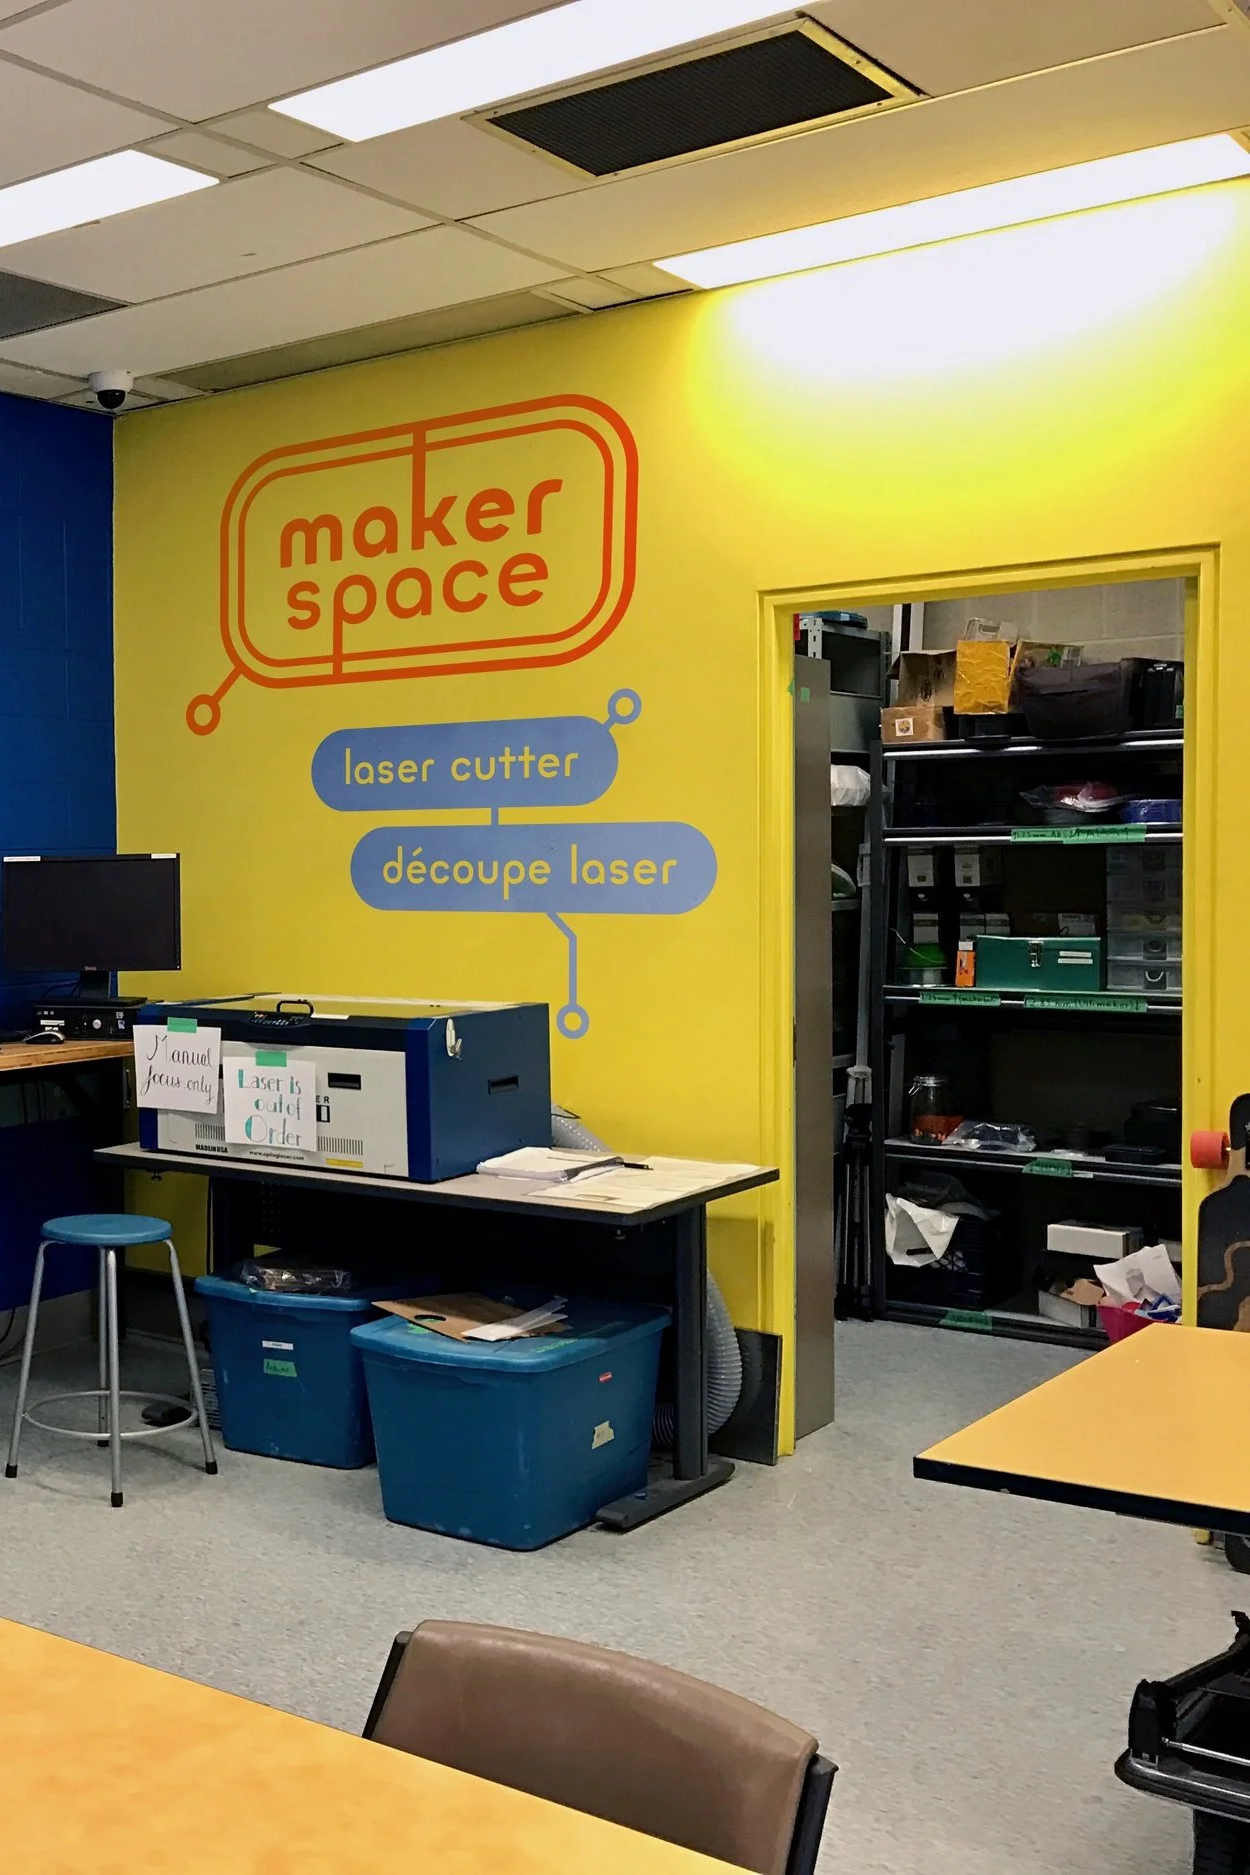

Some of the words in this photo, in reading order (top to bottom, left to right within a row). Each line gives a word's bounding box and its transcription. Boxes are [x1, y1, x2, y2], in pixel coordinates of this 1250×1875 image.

[280, 452, 563, 568] maker
[287, 552, 549, 652] space
[344, 747, 435, 785] laser
[450, 745, 579, 782] cutter
[382, 845, 551, 901] découpe
[570, 843, 678, 885] laser
[145, 1034, 214, 1068] Manual
[140, 1065, 182, 1097] focus
[186, 1074, 216, 1106] only
[237, 1068, 285, 1092] Laser
[289, 1075, 303, 1096] is
[254, 1093, 283, 1116] out
[286, 1096, 303, 1121] of
[244, 1114, 304, 1148] Order
